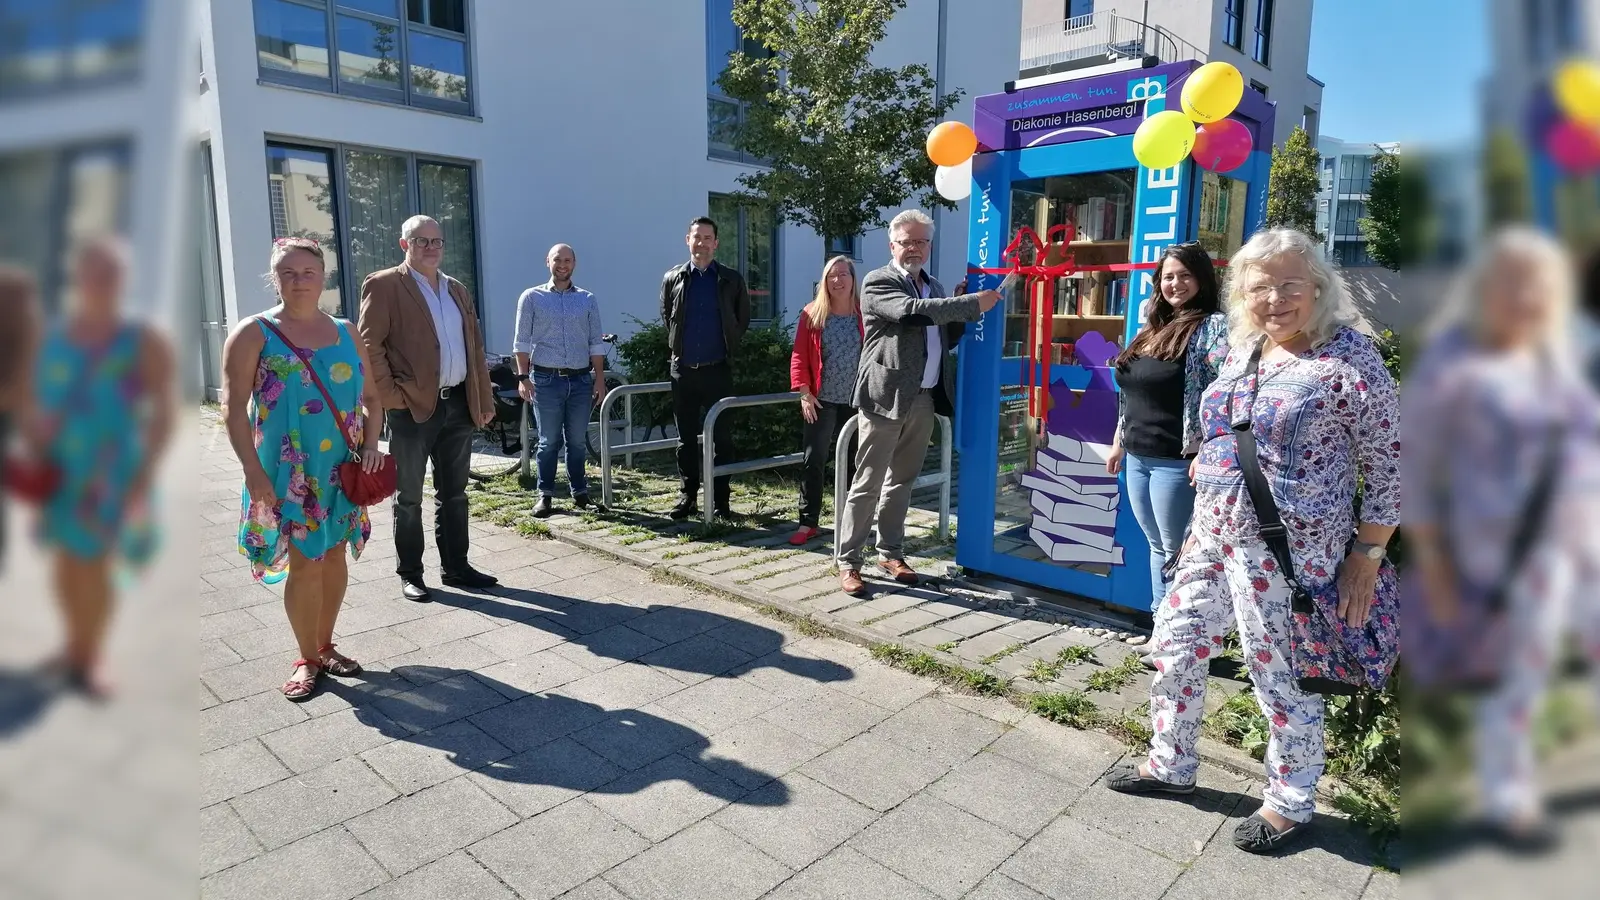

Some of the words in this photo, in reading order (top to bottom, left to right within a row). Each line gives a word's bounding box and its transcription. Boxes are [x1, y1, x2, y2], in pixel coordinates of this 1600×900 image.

[1008, 92, 1082, 112] zusammen.
[1087, 87, 1118, 98] tun.
[1012, 113, 1062, 132] Diakonie
[1065, 102, 1137, 124] Hasenbergl
[977, 181, 991, 224] tun.
